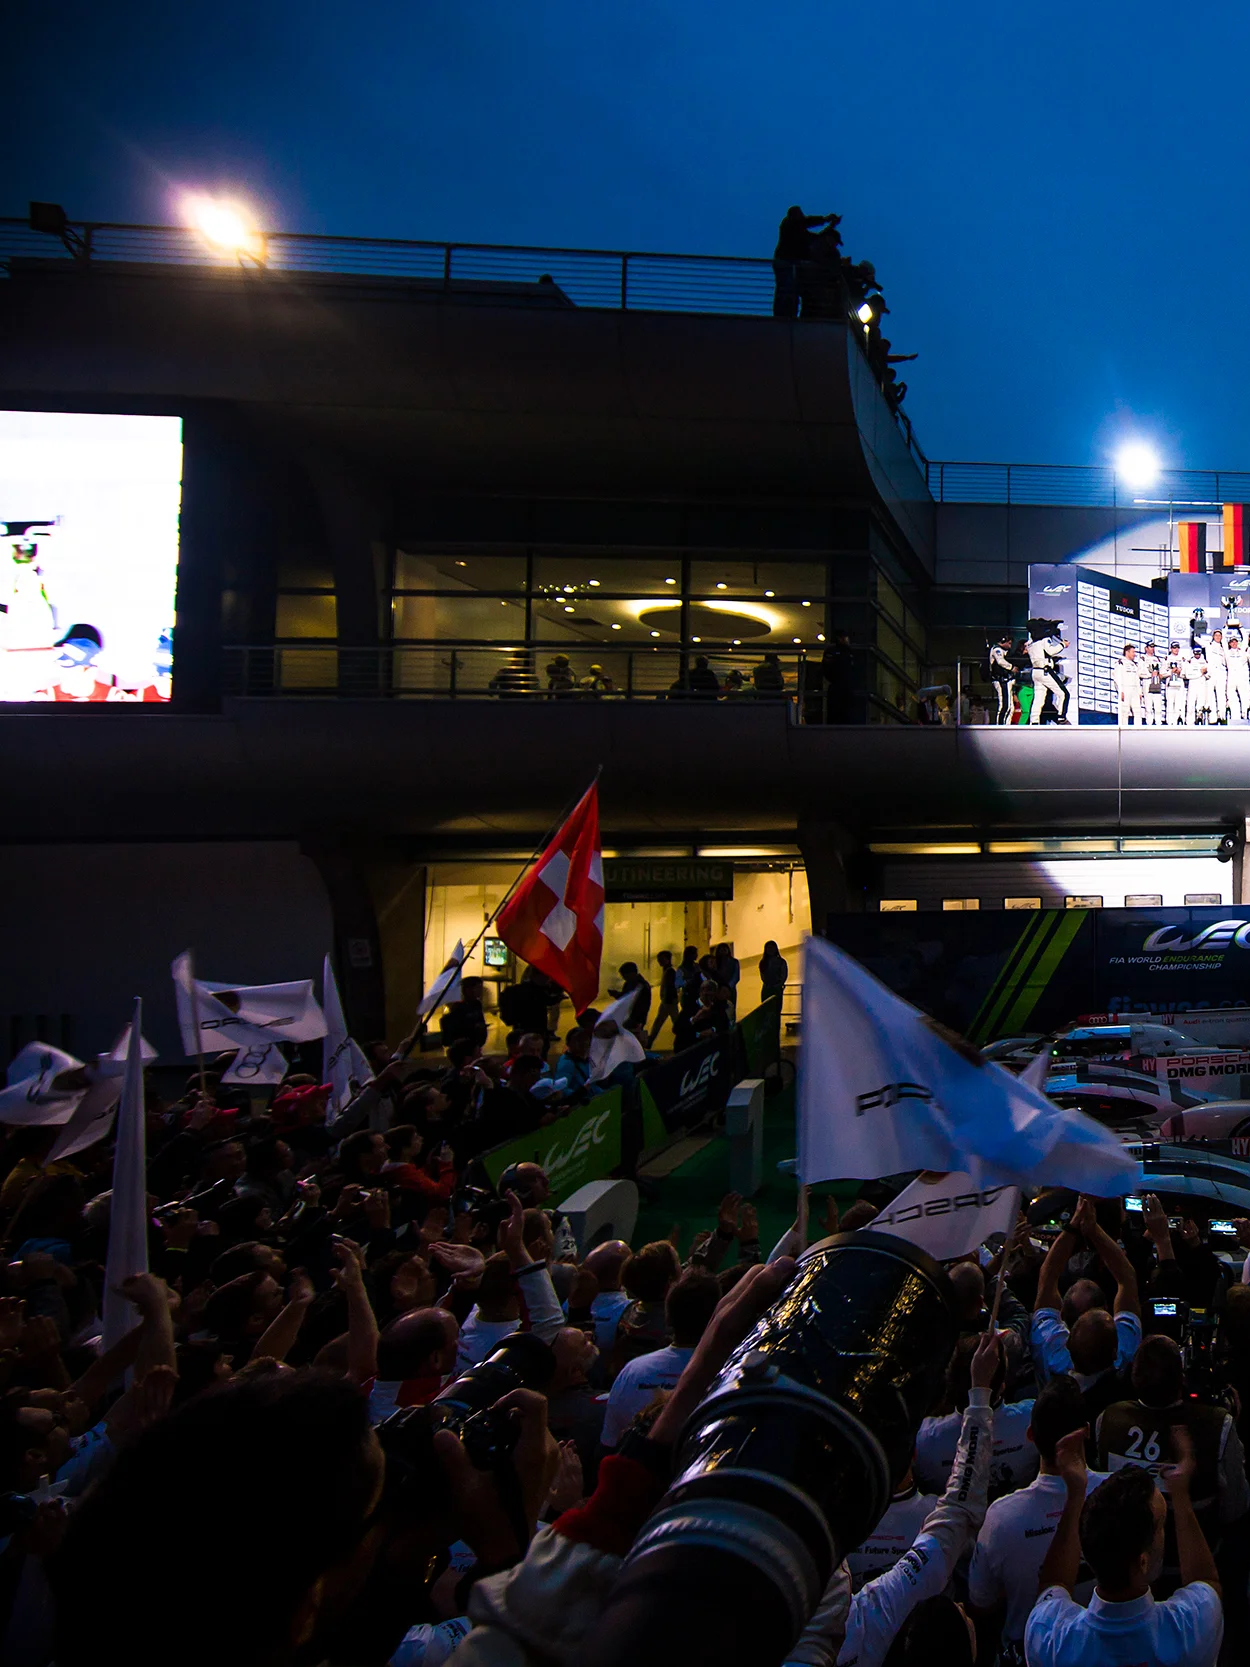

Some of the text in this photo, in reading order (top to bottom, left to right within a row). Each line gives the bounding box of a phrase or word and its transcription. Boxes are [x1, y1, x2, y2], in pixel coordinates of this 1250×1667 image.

[1115, 604, 1135, 615] TUDOR
[1109, 954, 1225, 964] FIA WORLD ENDURANCE
[1148, 962, 1222, 972] CHAMPIONSHIP
[1162, 1013, 1175, 1026] HY
[1141, 1058, 1157, 1073] HY
[1167, 1066, 1206, 1078] DMG
[679, 1050, 721, 1097] WEC
[543, 1109, 611, 1177] WEC
[1232, 1137, 1250, 1157] HY
[1125, 1425, 1161, 1462] 26
[958, 1425, 979, 1502] DMG MORI
[1025, 1526, 1055, 1538] Mission:
[865, 1546, 889, 1554] Future
